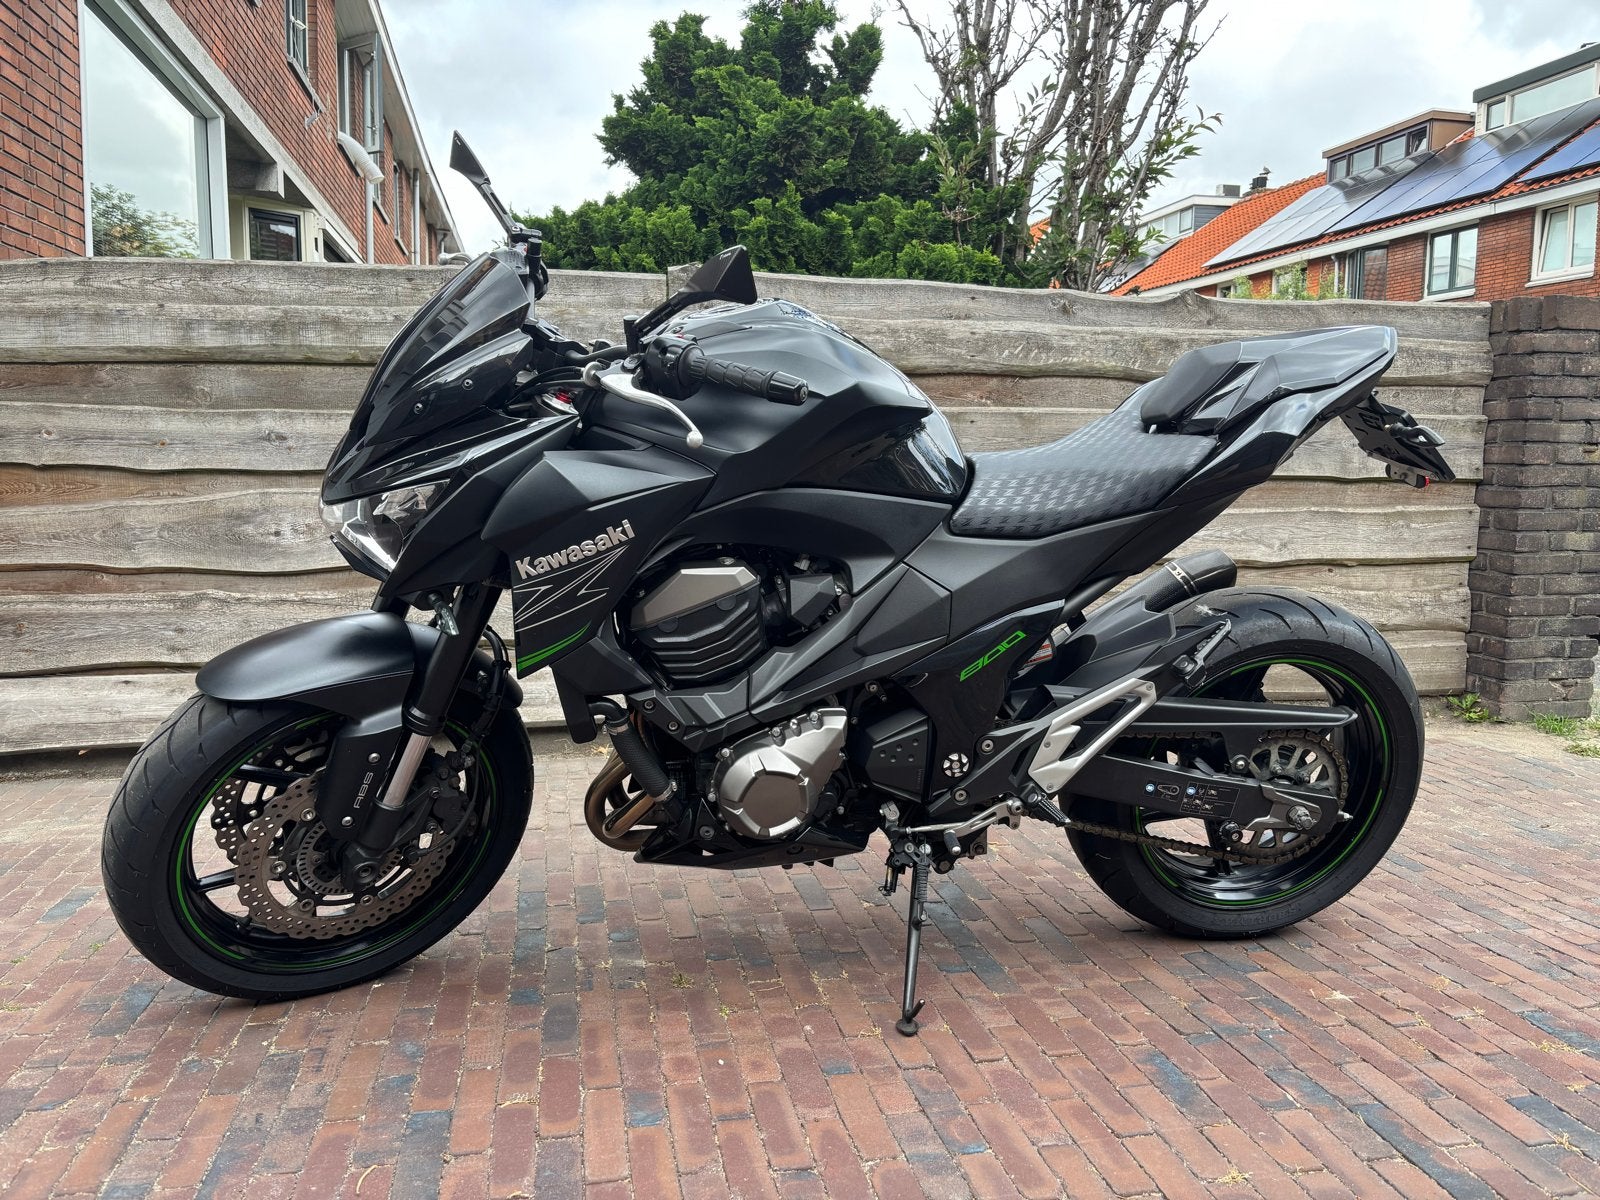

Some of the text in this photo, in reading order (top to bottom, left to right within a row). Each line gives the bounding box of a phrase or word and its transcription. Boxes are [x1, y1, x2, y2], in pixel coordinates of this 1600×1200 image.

[515, 519, 635, 580] Kawasaki
[960, 630, 1027, 682] 800
[353, 771, 374, 809] ABS
